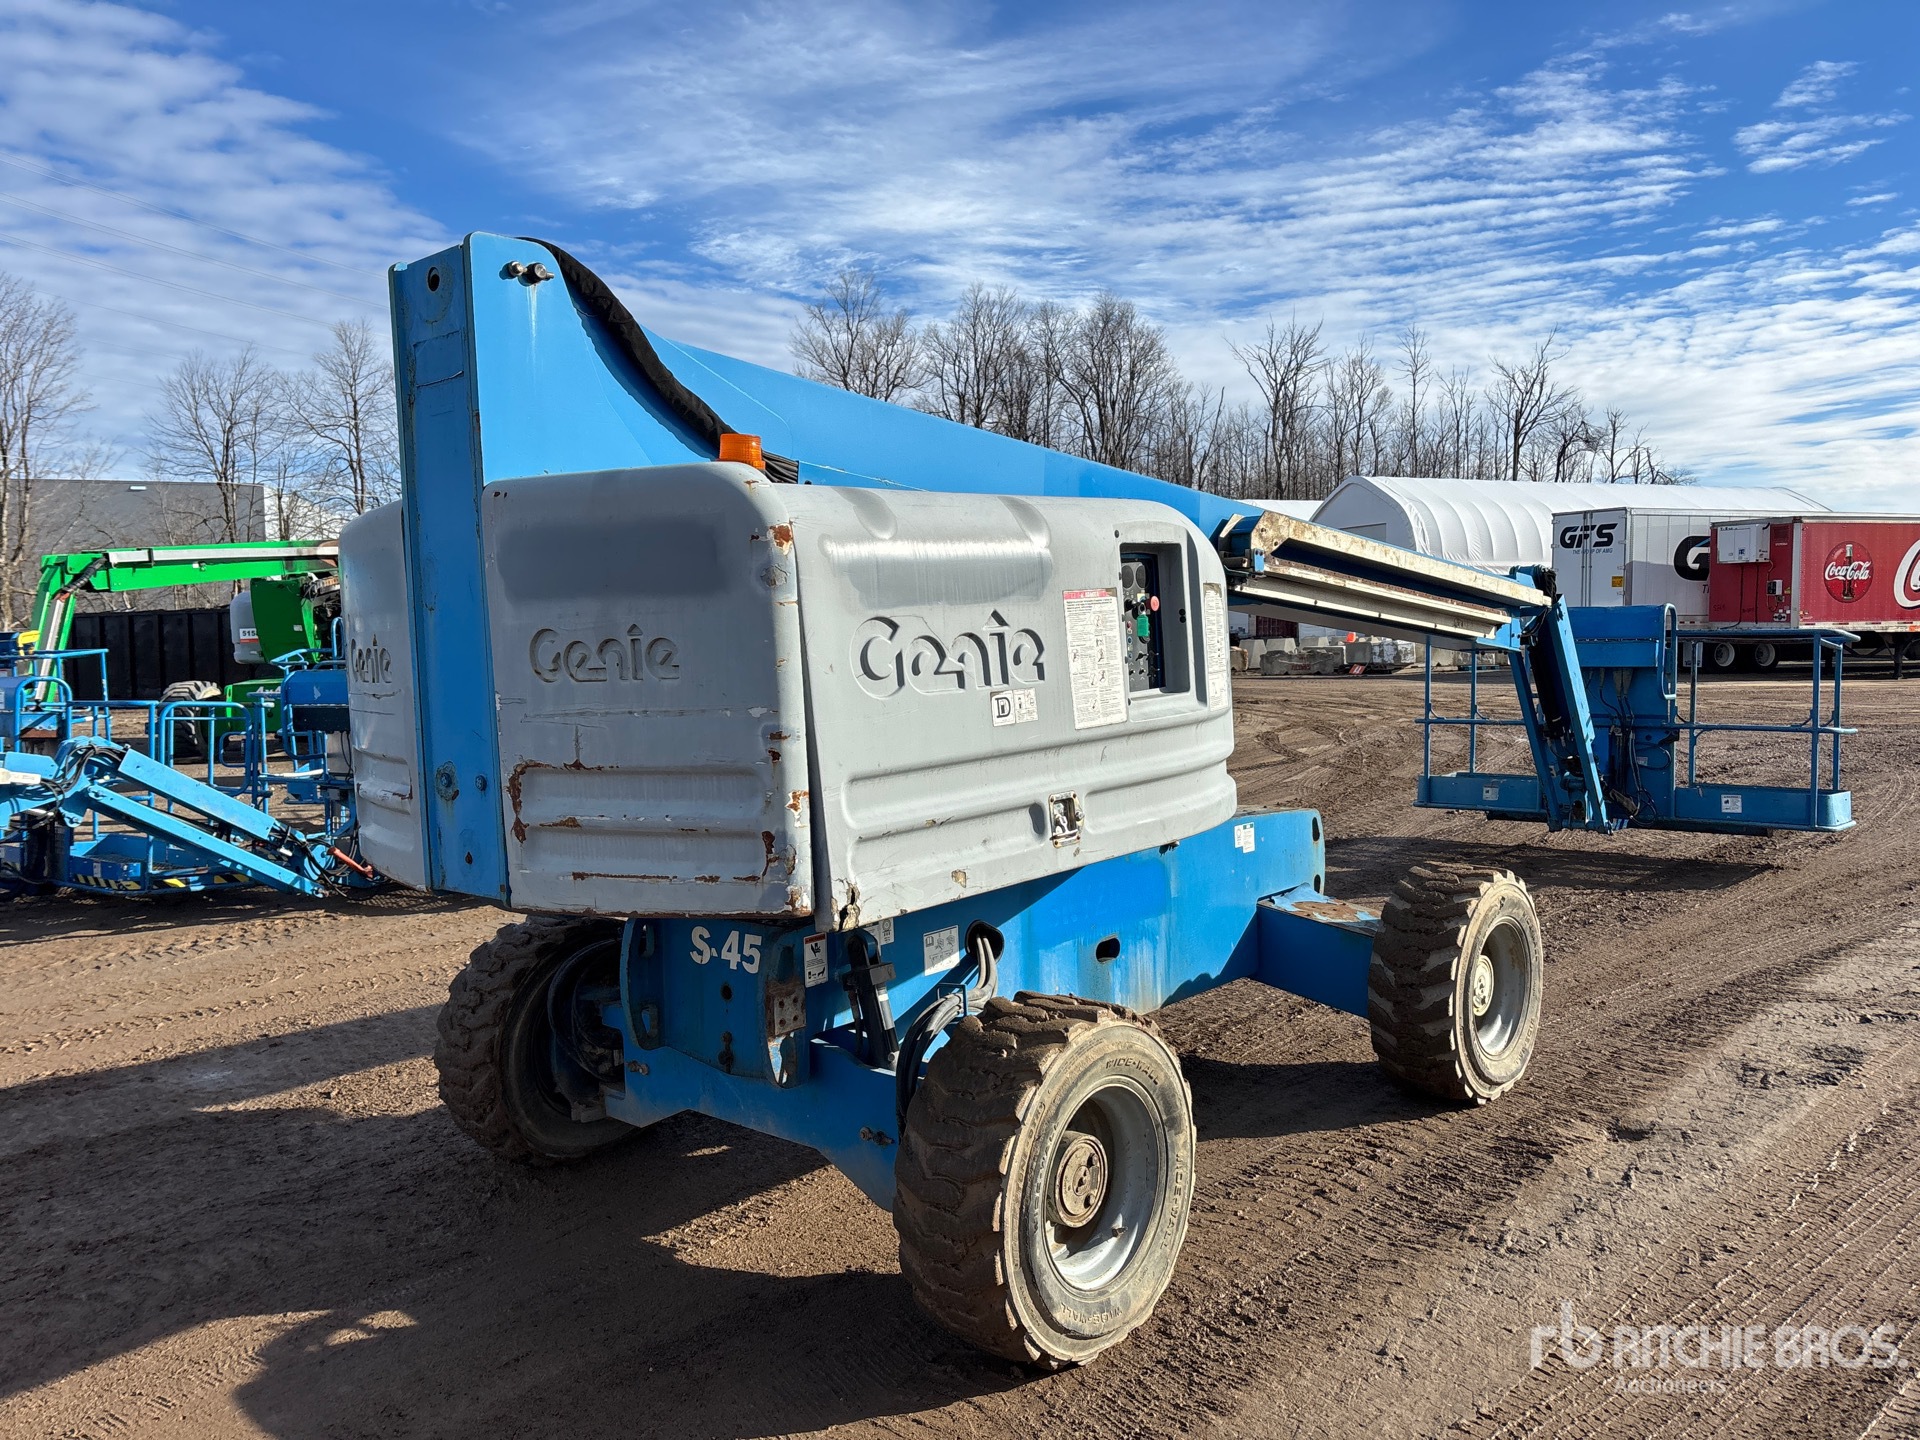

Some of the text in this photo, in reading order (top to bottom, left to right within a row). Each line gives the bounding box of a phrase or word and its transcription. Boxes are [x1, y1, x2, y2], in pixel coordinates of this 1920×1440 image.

[1560, 523, 1618, 549] GFS
[1825, 561, 1871, 580] Coca-Cola
[350, 634, 393, 684] Genie
[529, 623, 680, 683] Genie
[850, 609, 1045, 699] Genie
[690, 926, 762, 974] S-45
